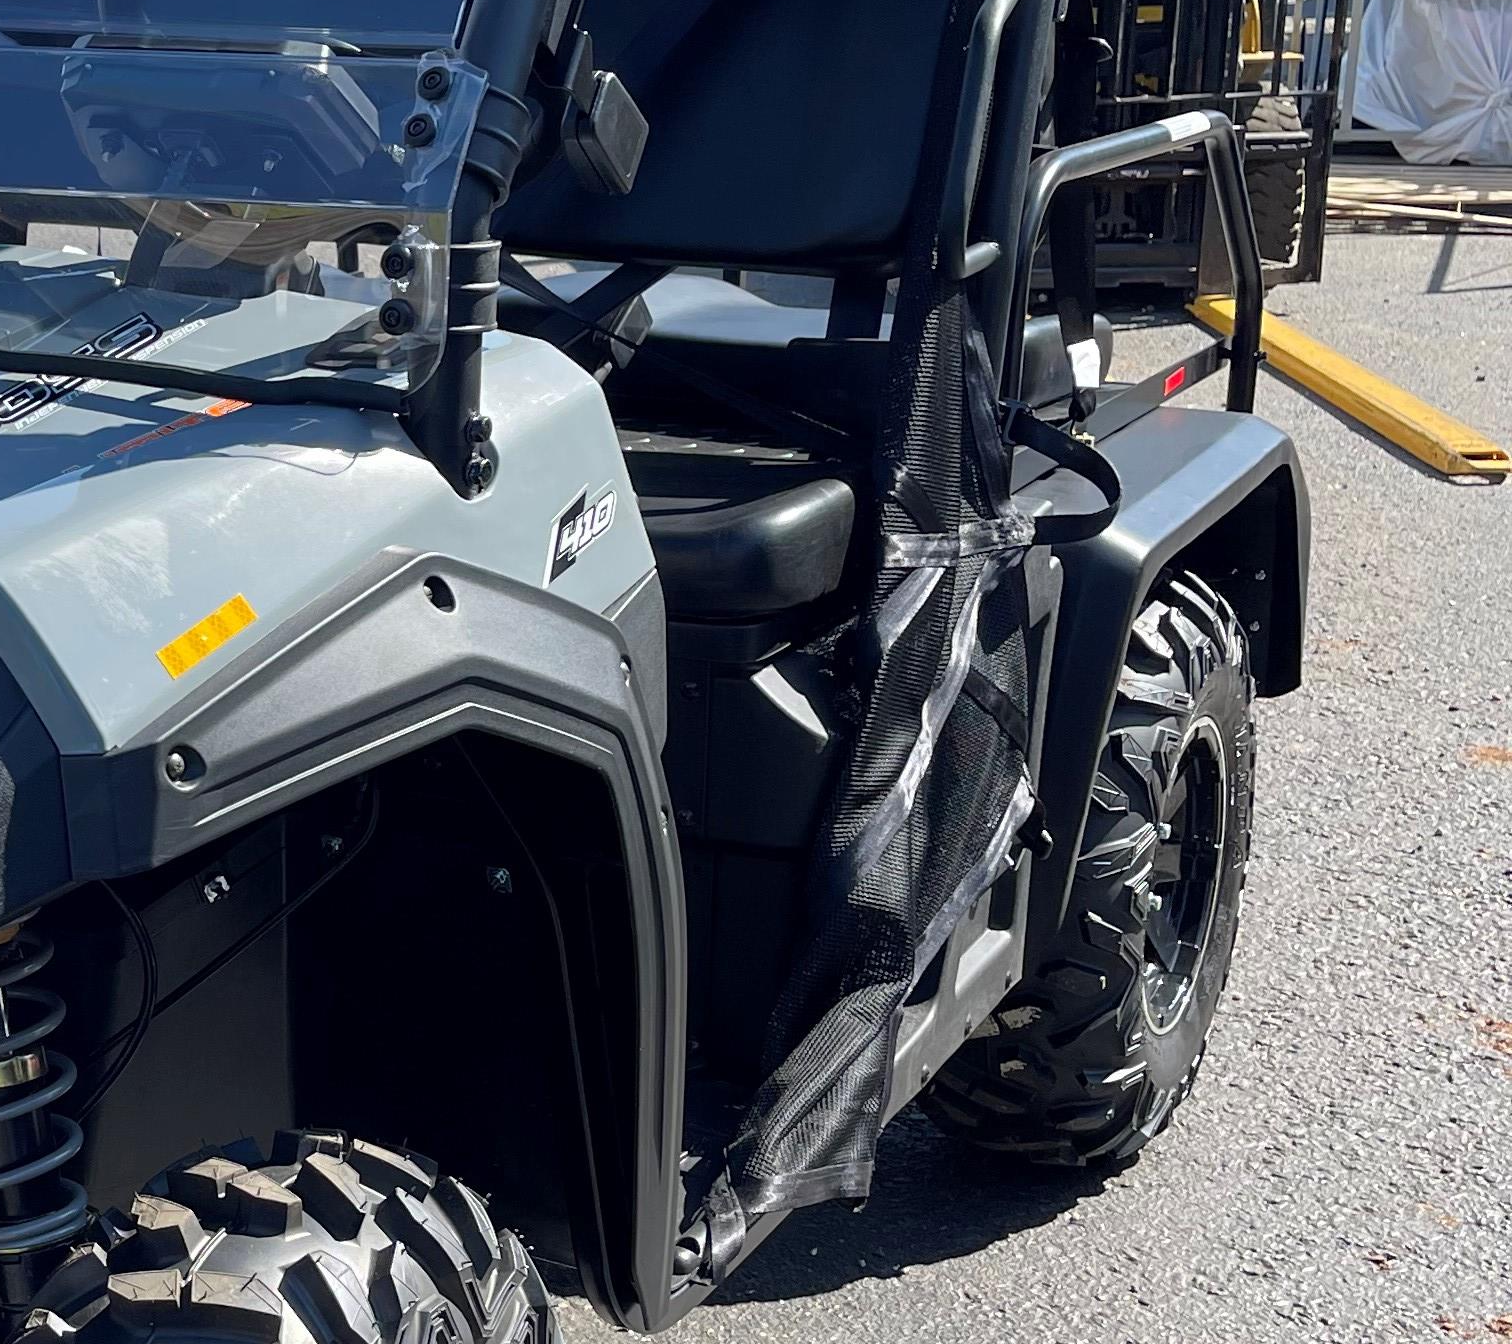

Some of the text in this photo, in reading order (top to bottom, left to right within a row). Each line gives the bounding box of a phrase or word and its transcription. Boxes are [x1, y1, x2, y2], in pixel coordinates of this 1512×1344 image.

[14, 379, 109, 432] INDEPENDE
[127, 318, 209, 361] SPENSION
[556, 490, 617, 561] 410
